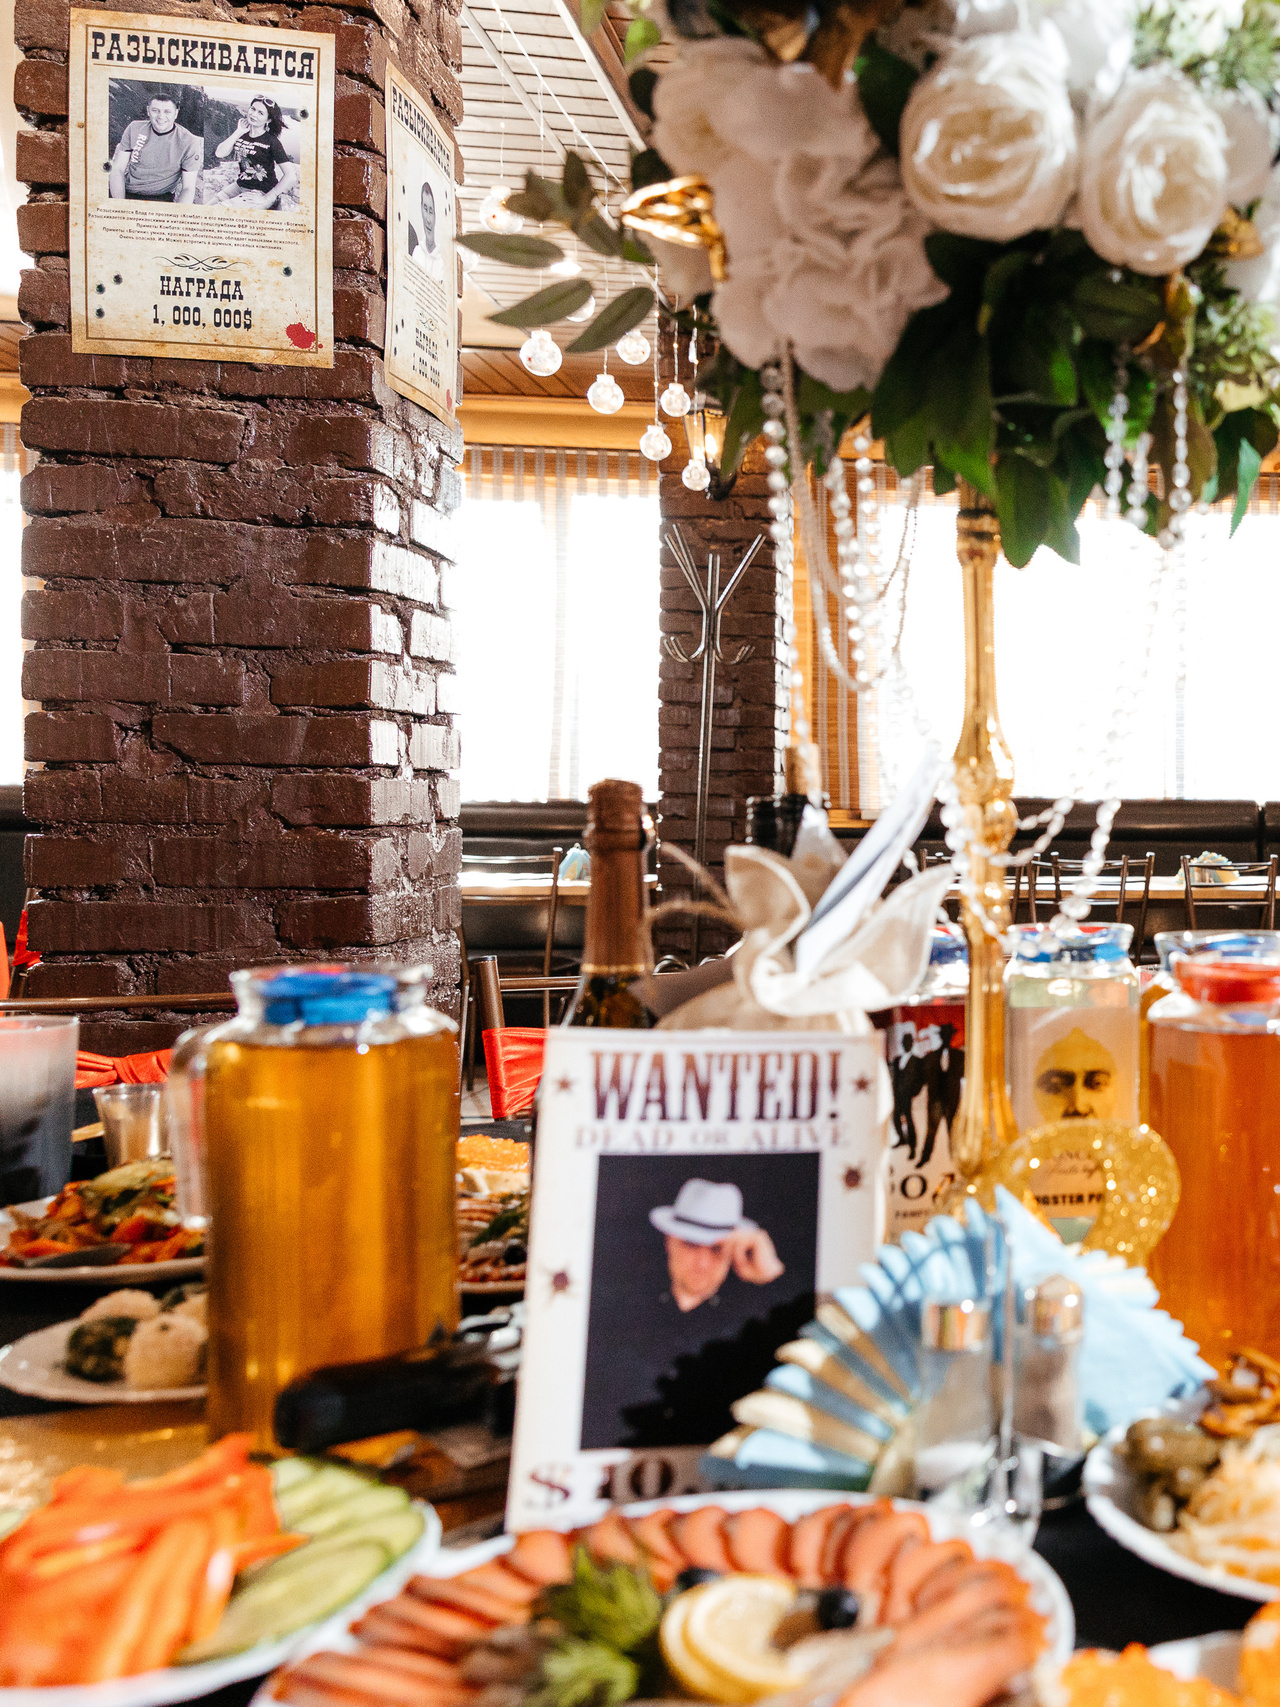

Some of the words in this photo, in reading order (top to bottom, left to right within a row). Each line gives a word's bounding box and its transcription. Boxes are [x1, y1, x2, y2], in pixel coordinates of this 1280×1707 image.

[91, 31, 315, 80] РАЗЫСКИВАЕТСЯ
[392, 86, 451, 179] РАЗЫСКИВАЕТСЯ
[160, 275, 243, 302] НАГРАДА
[213, 308, 252, 332] 000$
[590, 1050, 842, 1121] WANTED!
[575, 1123, 674, 1150] DEAD
